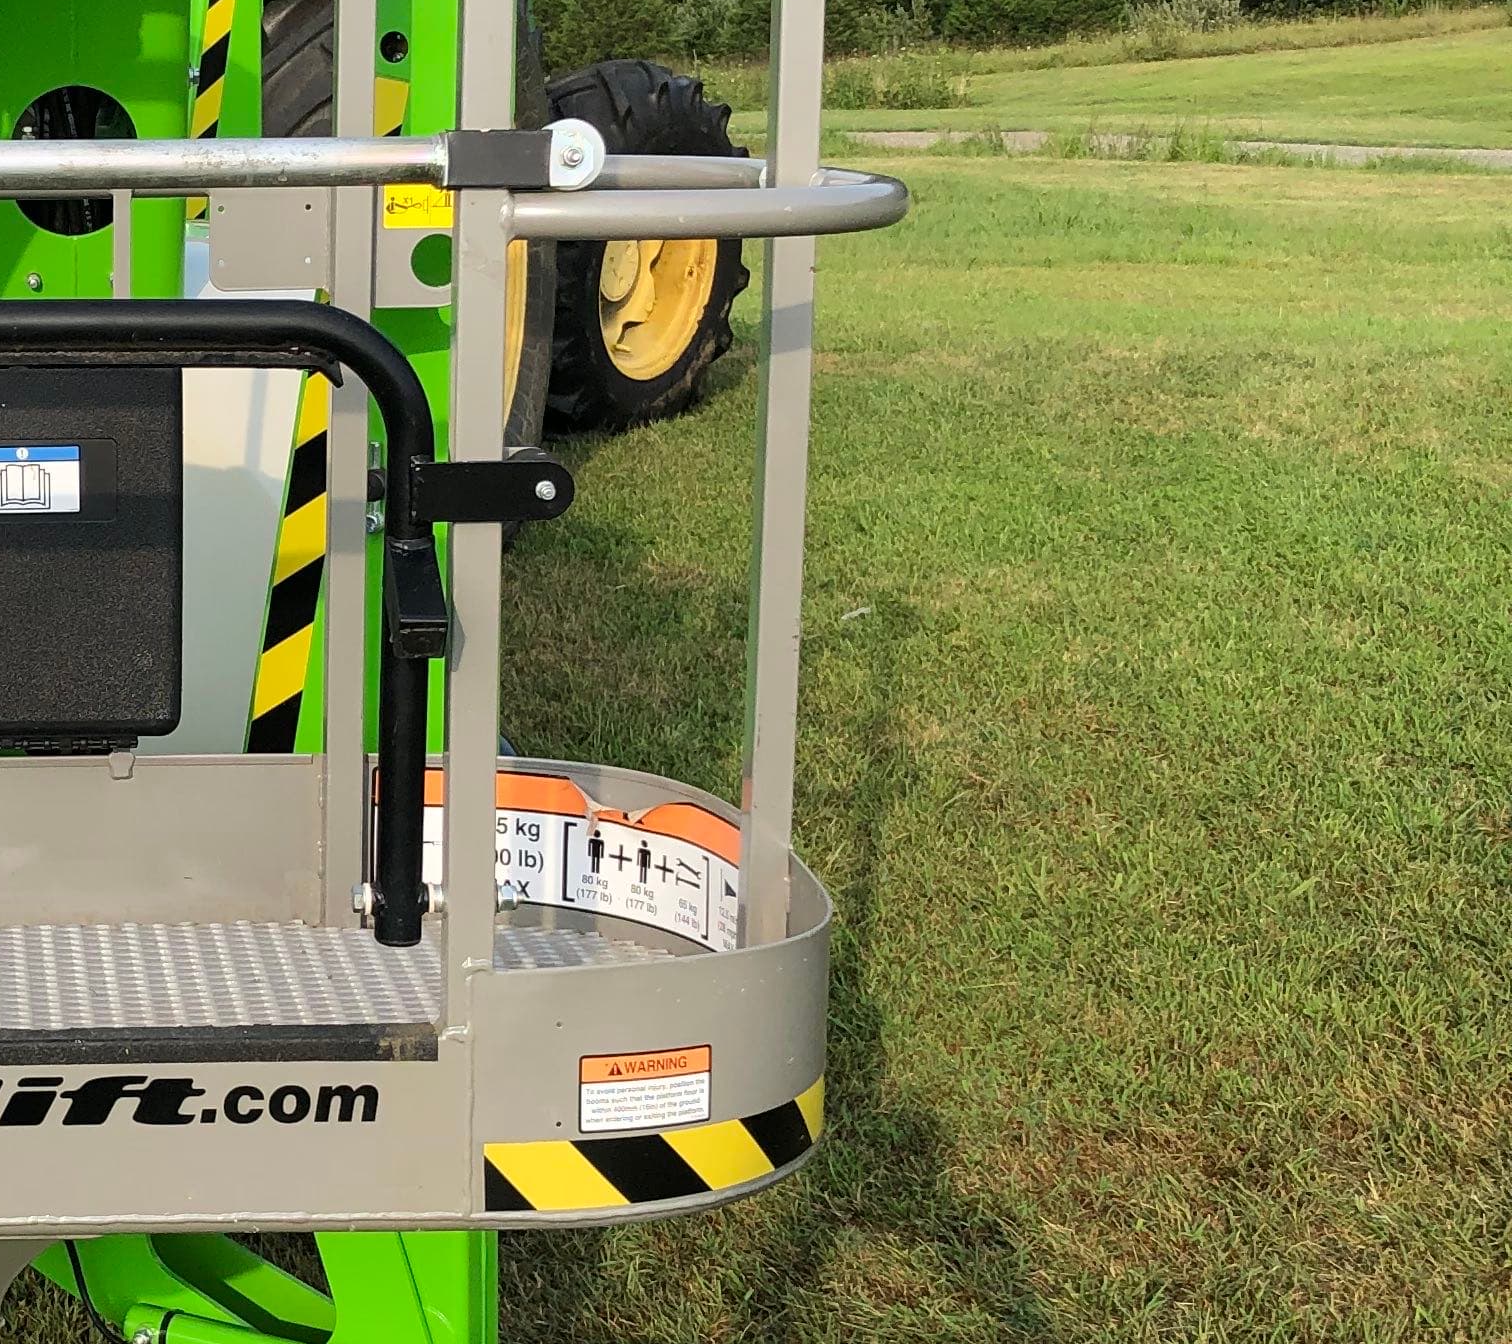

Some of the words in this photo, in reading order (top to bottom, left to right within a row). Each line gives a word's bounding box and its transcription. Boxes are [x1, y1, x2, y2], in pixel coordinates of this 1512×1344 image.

[515, 817, 541, 842] kg
[518, 849, 544, 873] lb)
[581, 874, 594, 884] 80
[596, 877, 609, 890] kg
[576, 887, 597, 900] (177
[600, 891, 613, 905] lb)
[643, 886, 654, 900] kg
[625, 897, 644, 911] (177
[646, 903, 658, 916] lb)
[688, 901, 698, 916] kg
[624, 1056, 687, 1074] WARNING
[669, 1080, 694, 1089] position
[679, 1098, 701, 1107] ground
